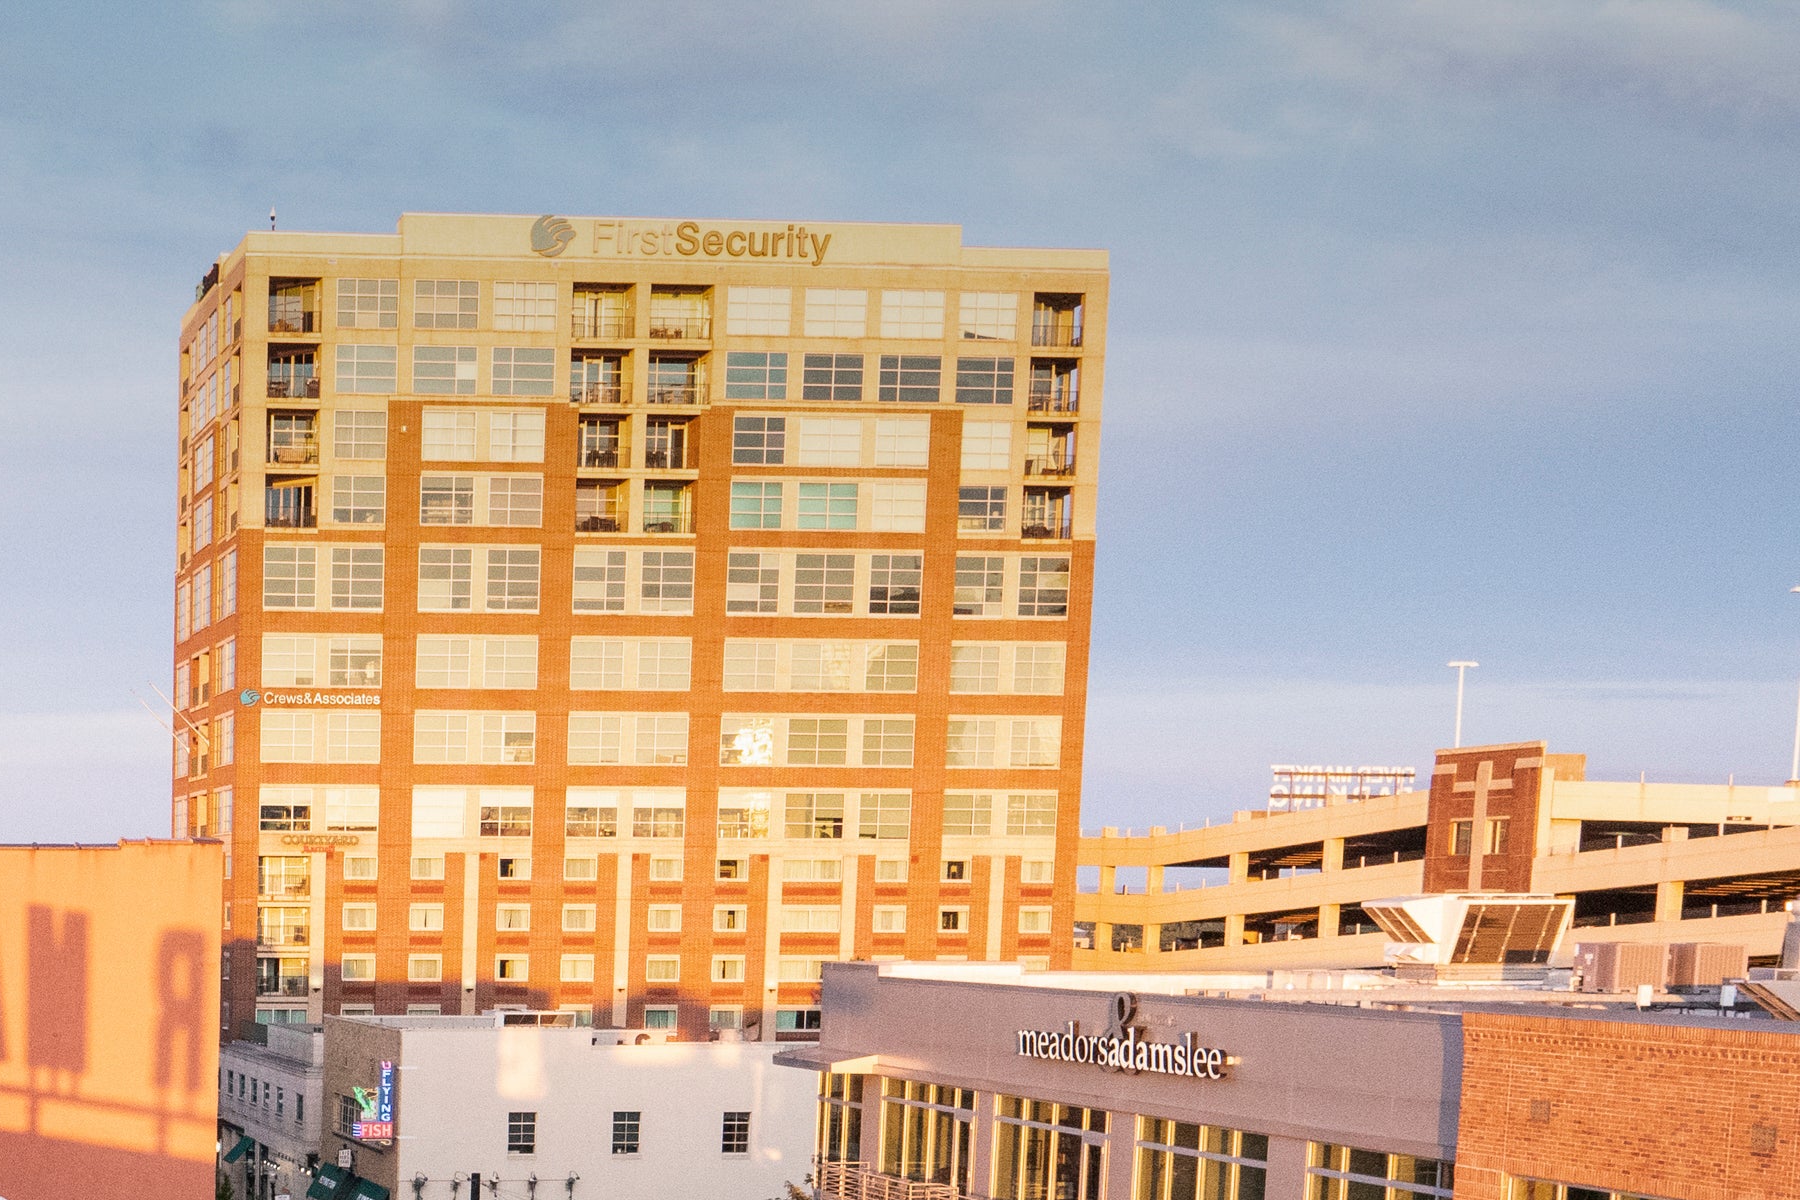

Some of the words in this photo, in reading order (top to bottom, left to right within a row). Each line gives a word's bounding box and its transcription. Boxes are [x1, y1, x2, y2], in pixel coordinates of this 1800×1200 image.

[592, 220, 832, 266] FirstSecurity
[263, 691, 381, 706] Crews&Associates
[1017, 1021, 1222, 1080] meadorsadamslee
[381, 1069, 392, 1122] FLYING
[362, 1123, 392, 1138] FISH
